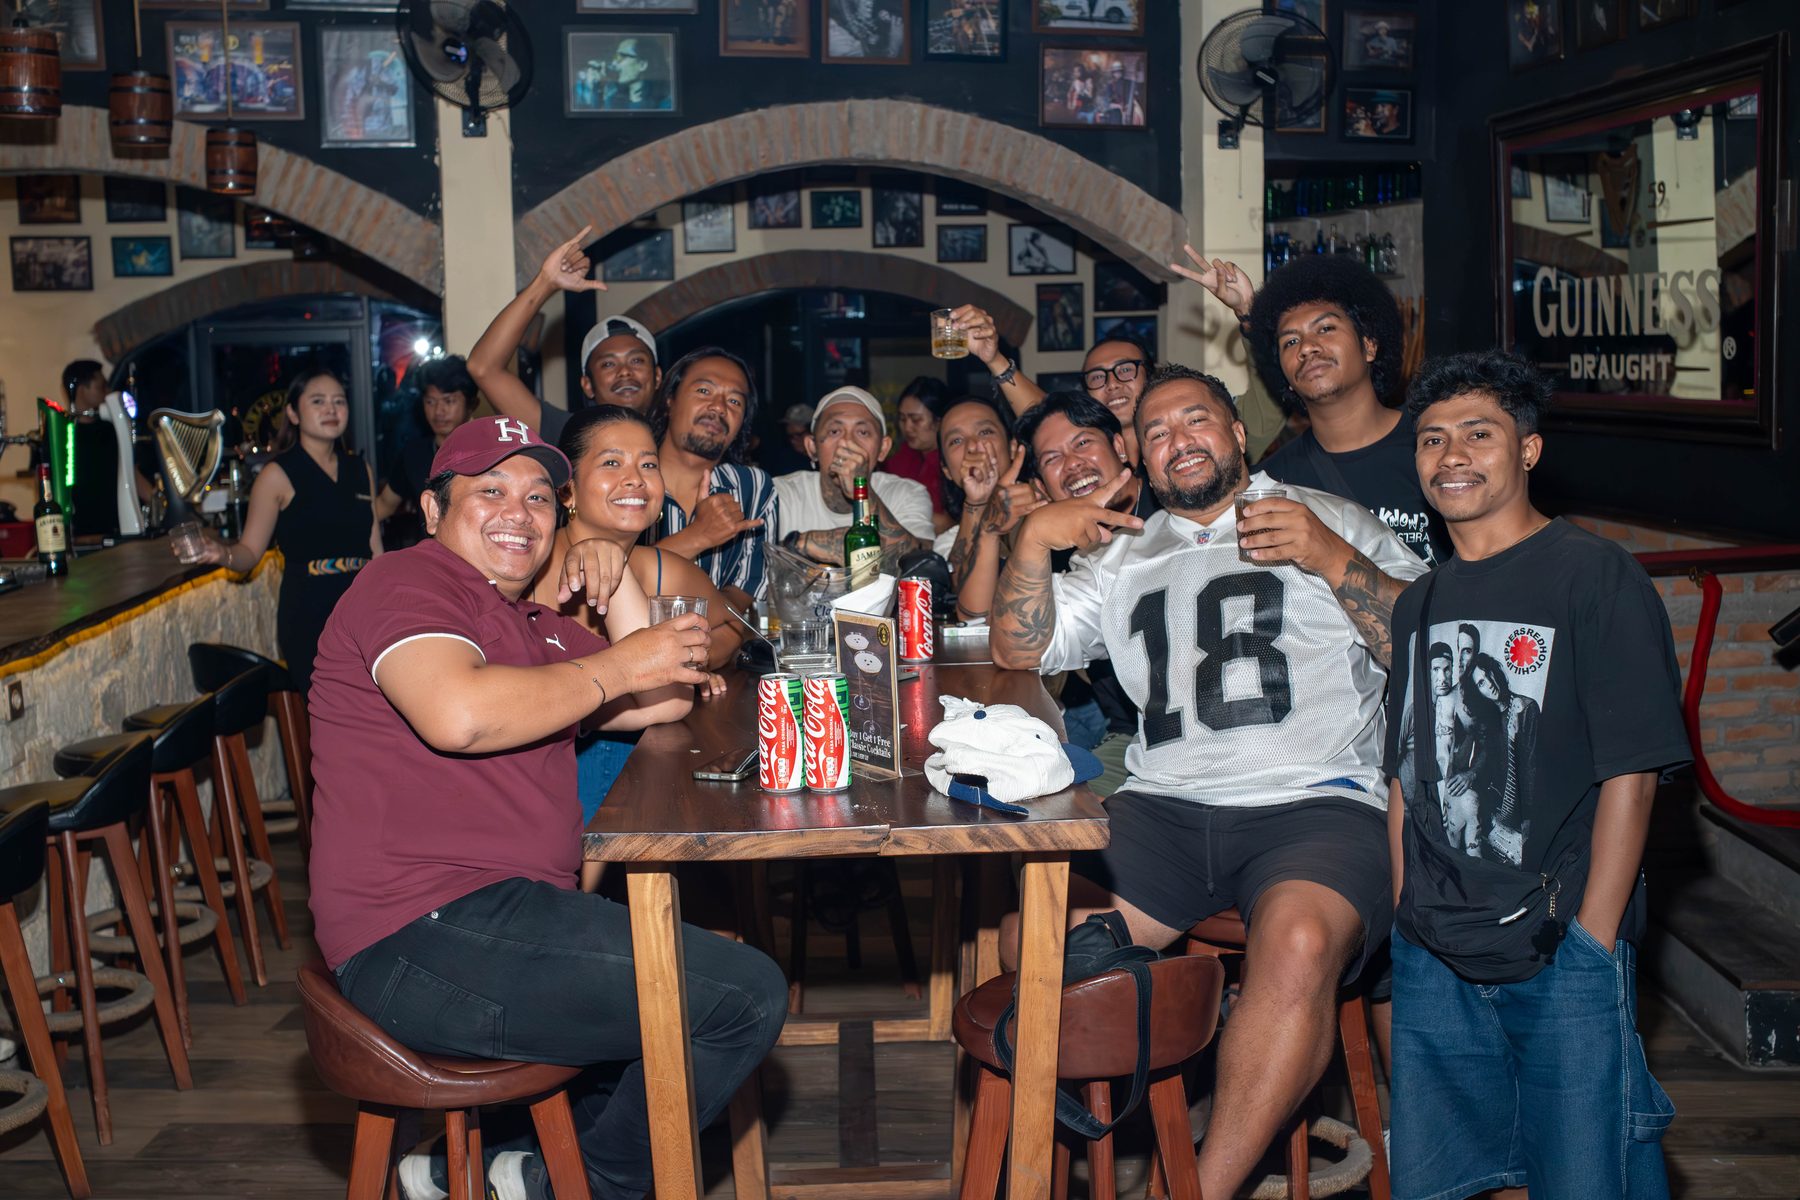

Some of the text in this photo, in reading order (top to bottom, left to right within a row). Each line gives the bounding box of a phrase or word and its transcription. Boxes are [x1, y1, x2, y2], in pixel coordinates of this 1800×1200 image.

[1533, 267, 1722, 337] GUINNESS
[1570, 353, 1673, 381] DRAUGHT
[494, 417, 532, 444] H
[1129, 571, 1296, 751] 18
[850, 740, 867, 752] lassic
[867, 744, 891, 758] Cocktails
[877, 736, 891, 747] Free
